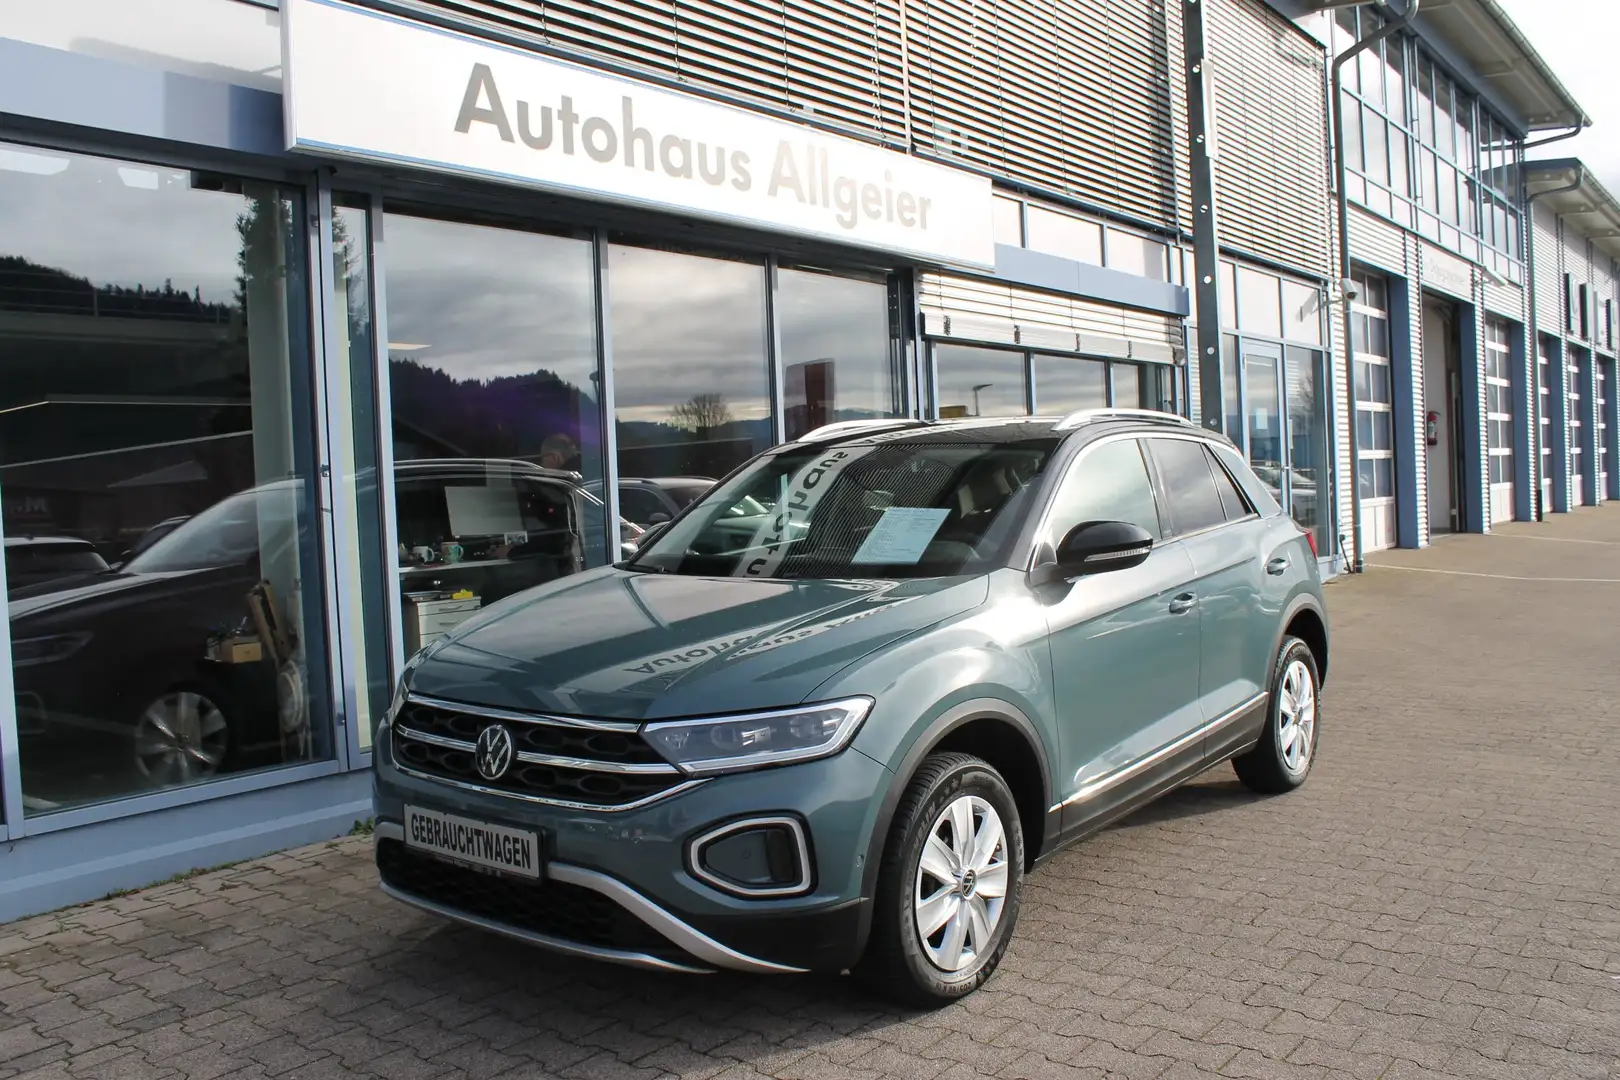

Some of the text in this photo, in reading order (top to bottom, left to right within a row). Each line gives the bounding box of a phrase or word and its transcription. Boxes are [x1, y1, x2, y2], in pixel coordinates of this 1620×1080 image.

[454, 61, 932, 230] Autohaus Allgeier
[411, 812, 531, 869] GEBRAUCHTWAGEN
